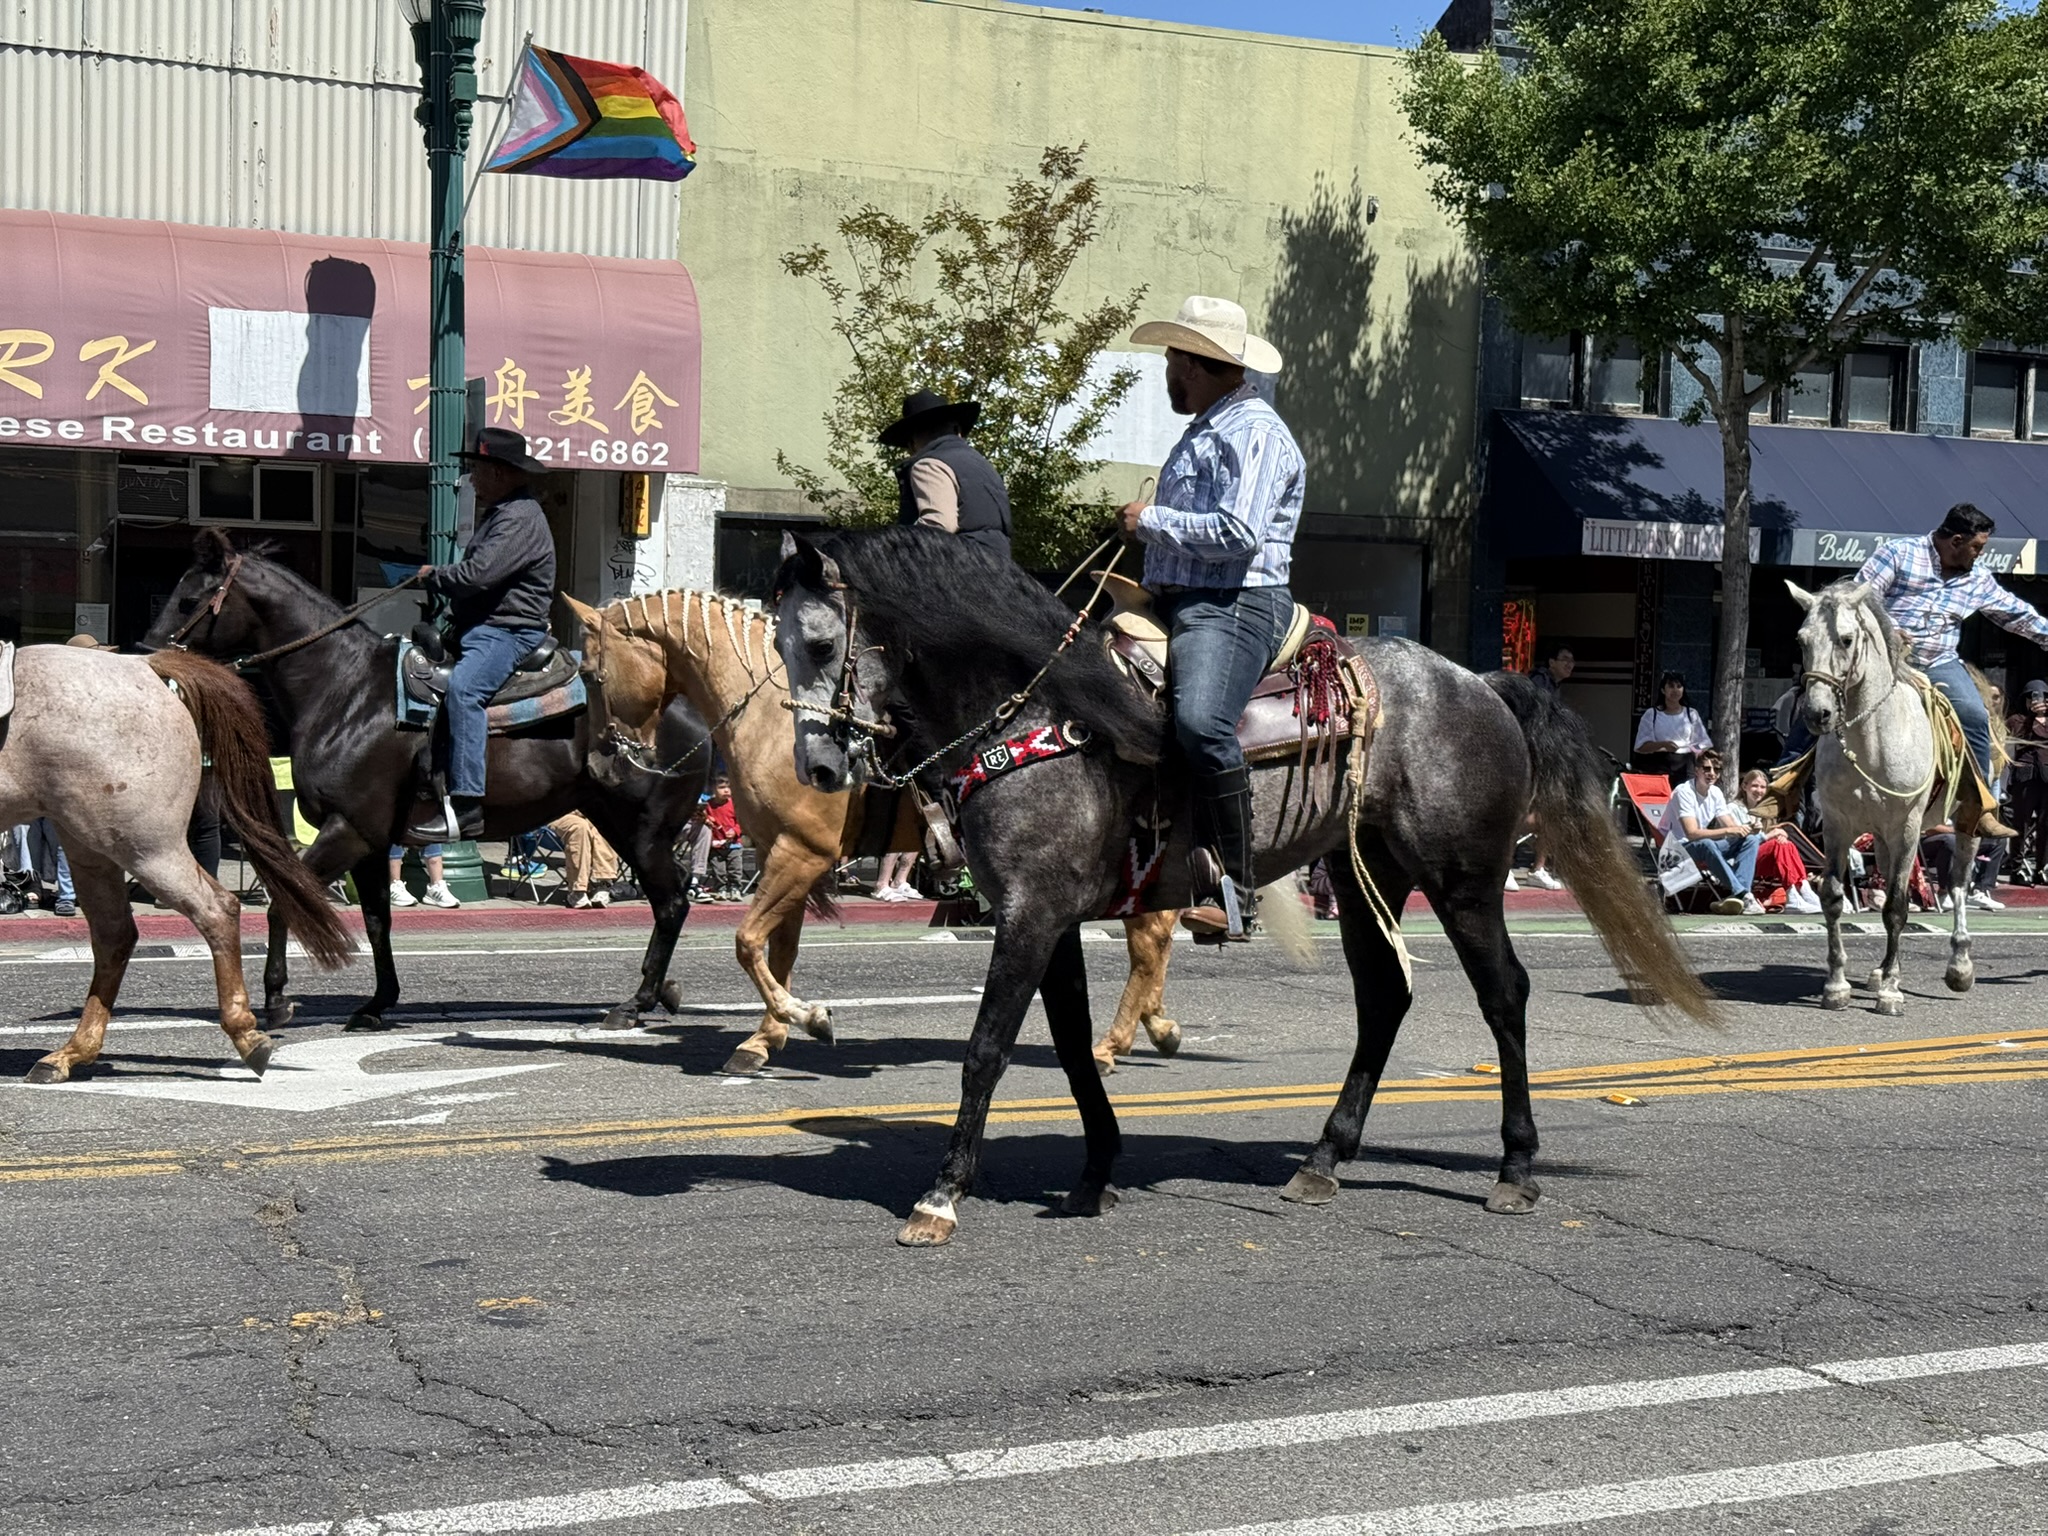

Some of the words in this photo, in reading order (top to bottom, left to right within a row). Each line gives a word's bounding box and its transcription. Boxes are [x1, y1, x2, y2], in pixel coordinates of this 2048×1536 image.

[0, 416, 85, 440] ese
[102, 416, 383, 455] Restaurant
[1590, 525, 1643, 554] LITTLE
[1818, 533, 1866, 562] Bella
[1349, 617, 1365, 625] IMP
